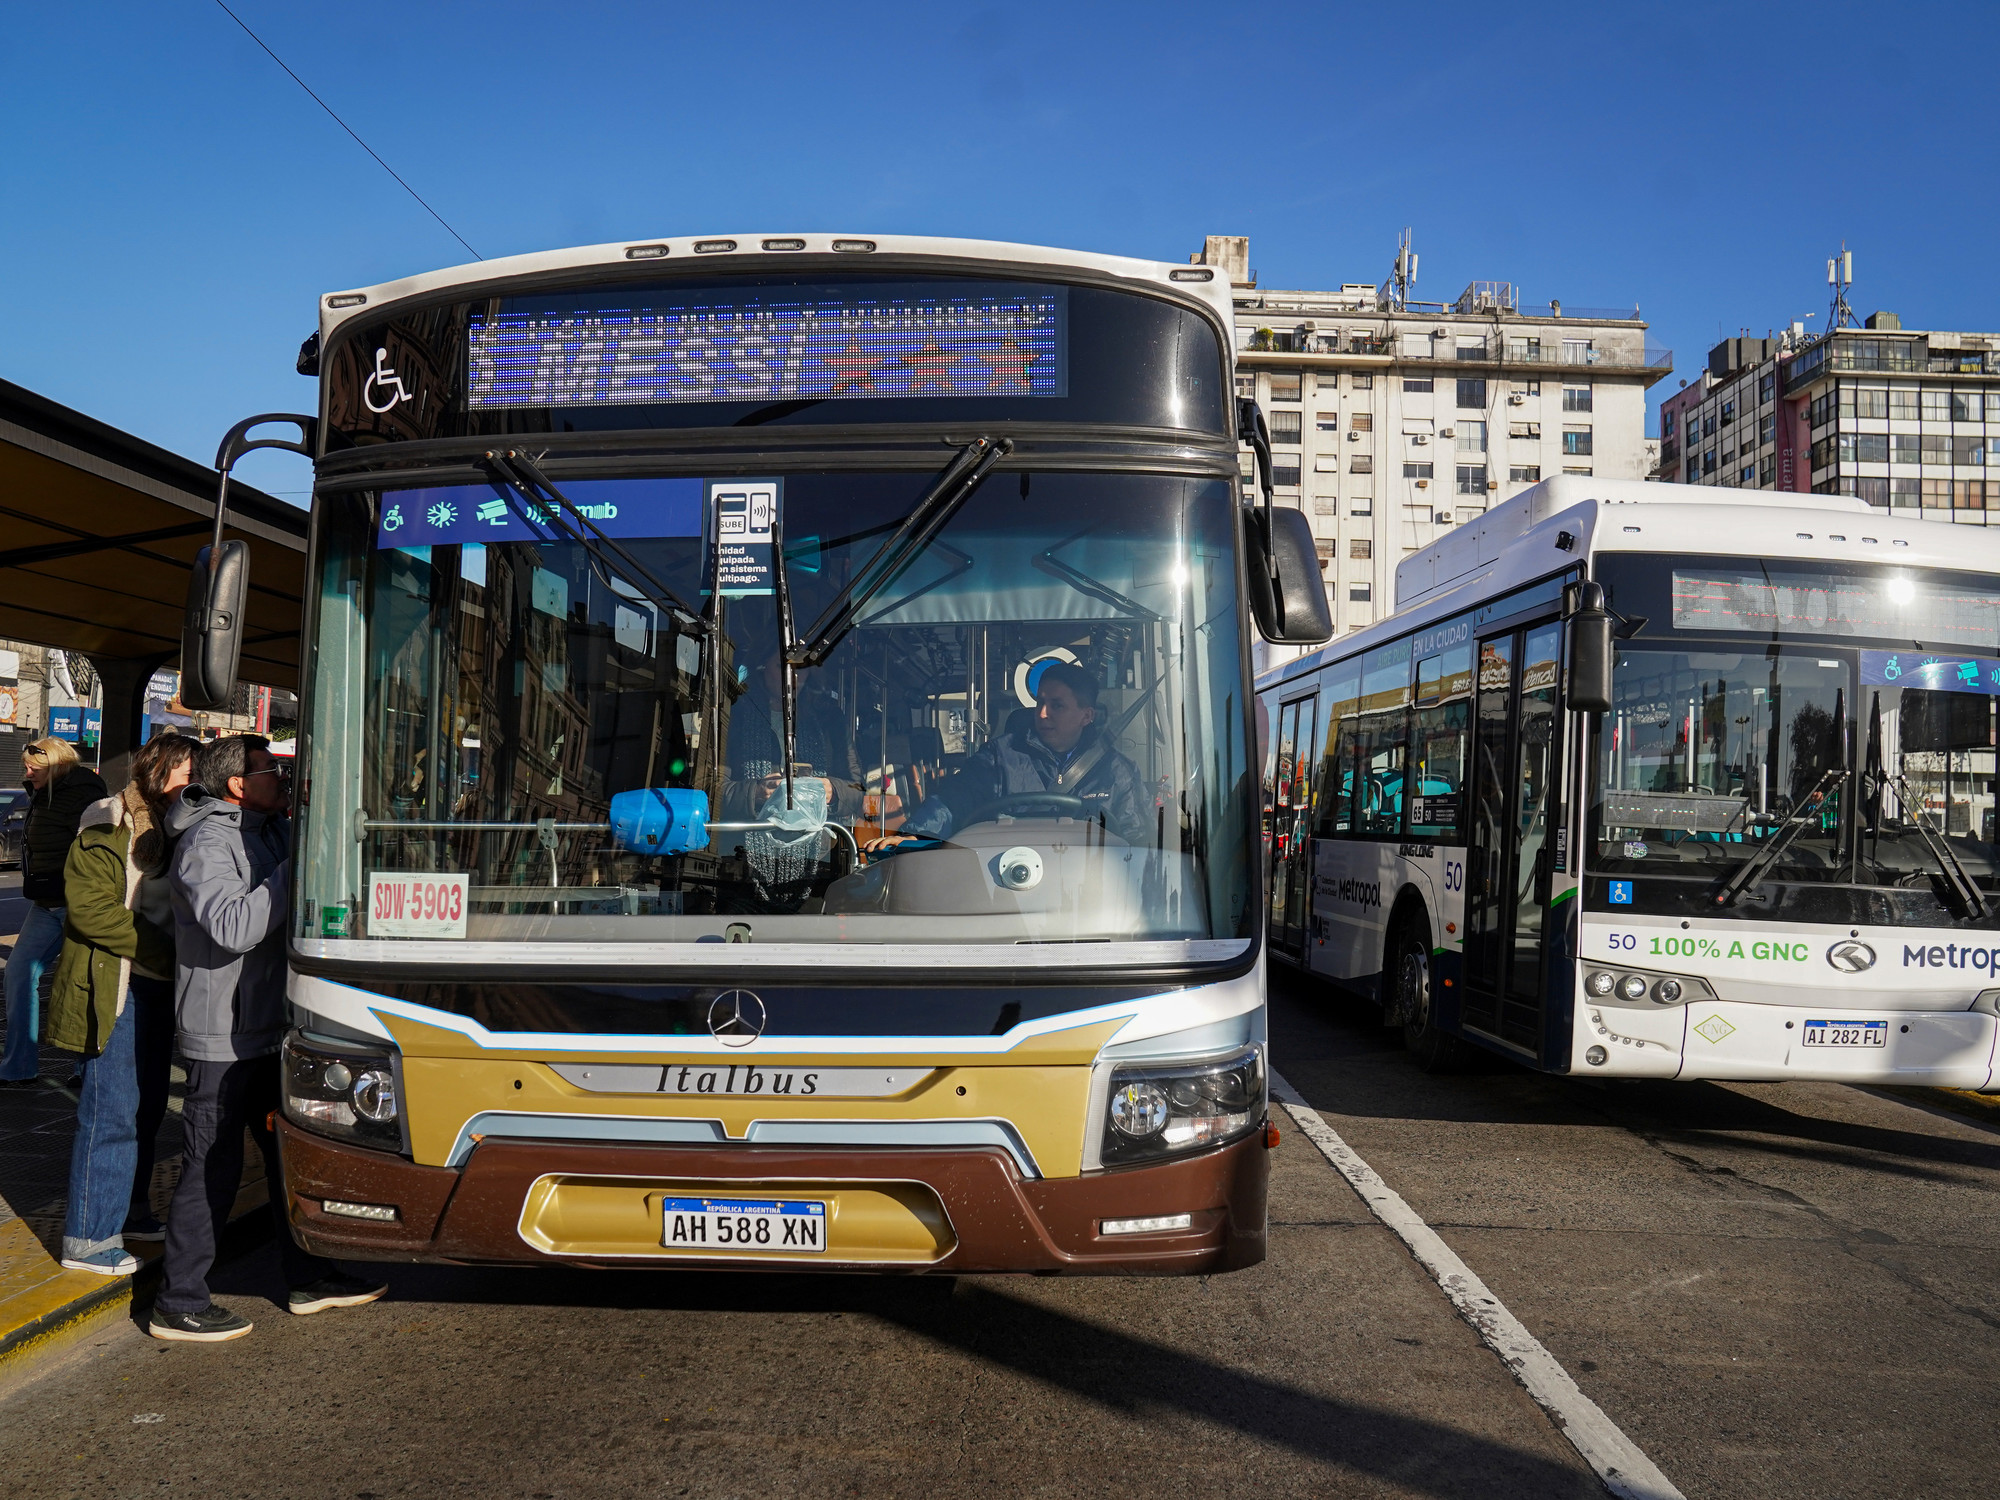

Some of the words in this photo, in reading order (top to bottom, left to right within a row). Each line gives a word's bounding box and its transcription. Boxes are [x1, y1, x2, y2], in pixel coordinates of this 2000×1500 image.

[530, 332, 807, 403] MESSI
[713, 574, 761, 583] ultipago.
[730, 564, 768, 573] sistema
[1413, 640, 1423, 657] EN
[1425, 635, 1435, 653] LA
[1436, 623, 1468, 649] CIUDAD
[1413, 806, 1422, 820] 65
[1445, 861, 1463, 892] 50
[375, 882, 462, 921] SDW-5903
[1338, 877, 1381, 914] Metropol
[1608, 933, 1637, 950] 50
[1649, 937, 1721, 959] 100%
[1727, 940, 1746, 959] A
[1751, 941, 1809, 962] GNC
[1903, 943, 2000, 978] Metrop
[1702, 1023, 1727, 1035] CNG
[1808, 1029, 1825, 1044] AI
[1831, 1029, 1860, 1044] 282
[1864, 1030, 1882, 1044] FL
[656, 1064, 819, 1095] Italbus
[706, 1204, 742, 1214] REPÚBLICA
[743, 1206, 781, 1215] ARGENTINA
[672, 1215, 707, 1242] AH
[717, 1216, 771, 1244] 588
[782, 1218, 817, 1246] XN
